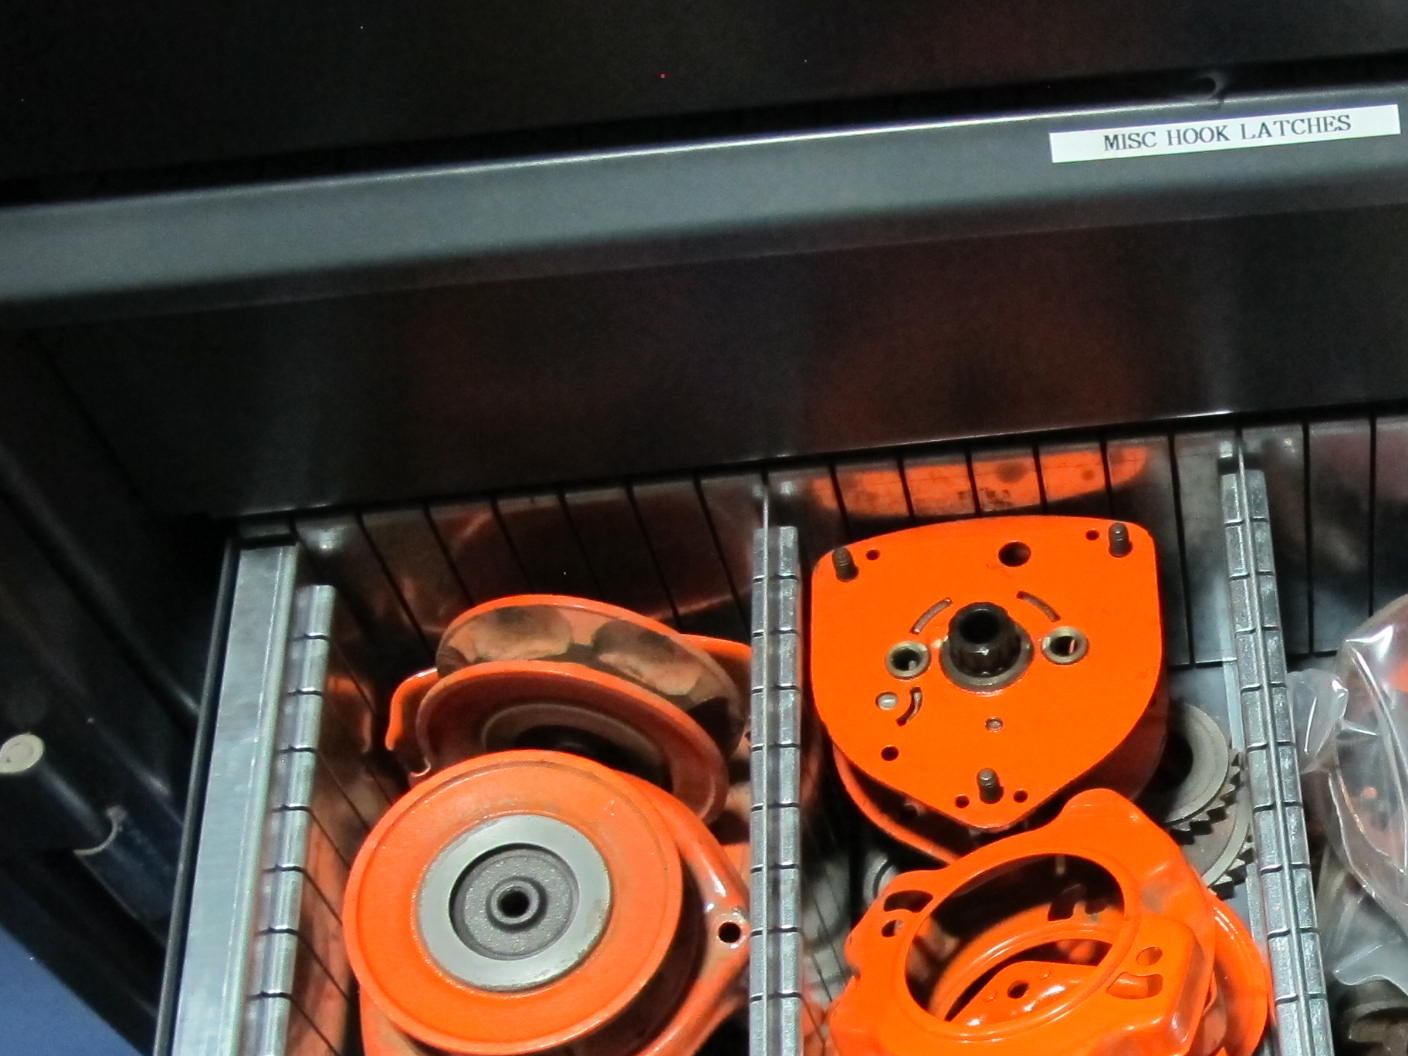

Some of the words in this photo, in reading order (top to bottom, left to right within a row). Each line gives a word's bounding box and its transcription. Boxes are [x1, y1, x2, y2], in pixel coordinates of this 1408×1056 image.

[1103, 131, 1157, 151] MISC
[1167, 125, 1230, 146] HOOK
[1240, 114, 1351, 140] LATCHES
